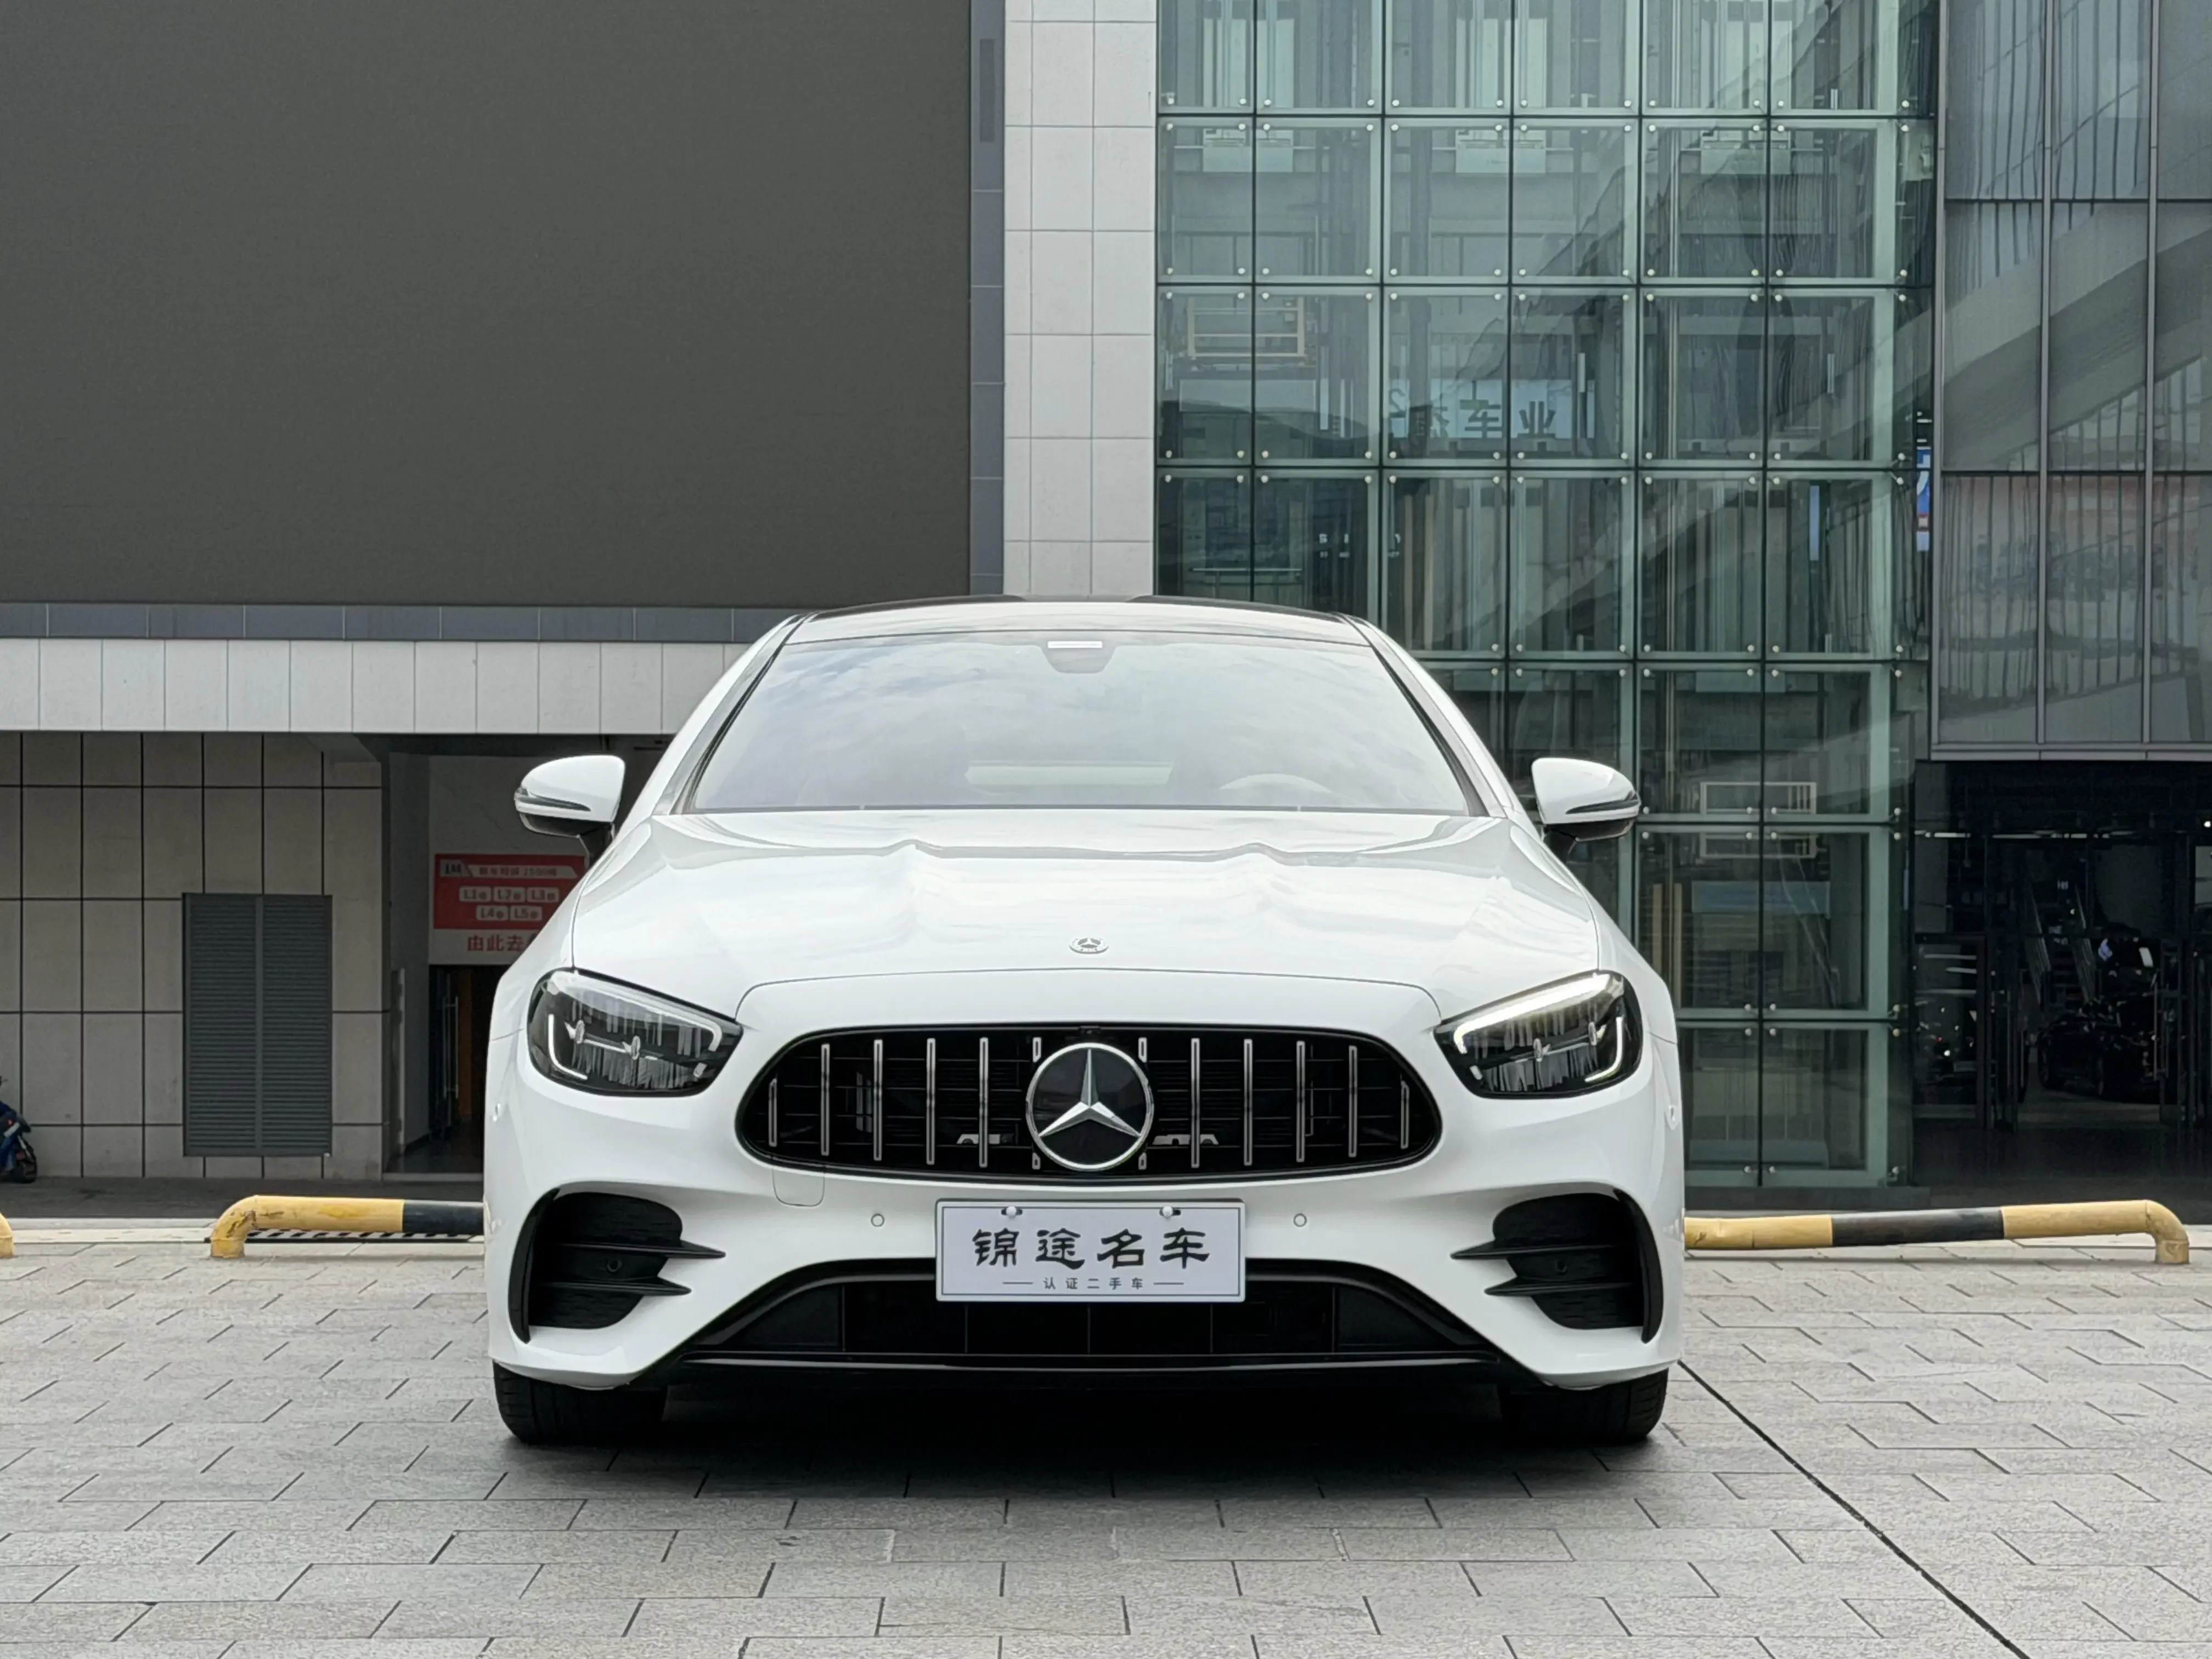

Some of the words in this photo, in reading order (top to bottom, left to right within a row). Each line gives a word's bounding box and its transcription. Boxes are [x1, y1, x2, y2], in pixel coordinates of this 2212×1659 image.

[467, 934, 531, 952] 由此去
[972, 1228, 1210, 1269] 锦途名车
[1043, 1277, 1144, 1290] 认证二手车
